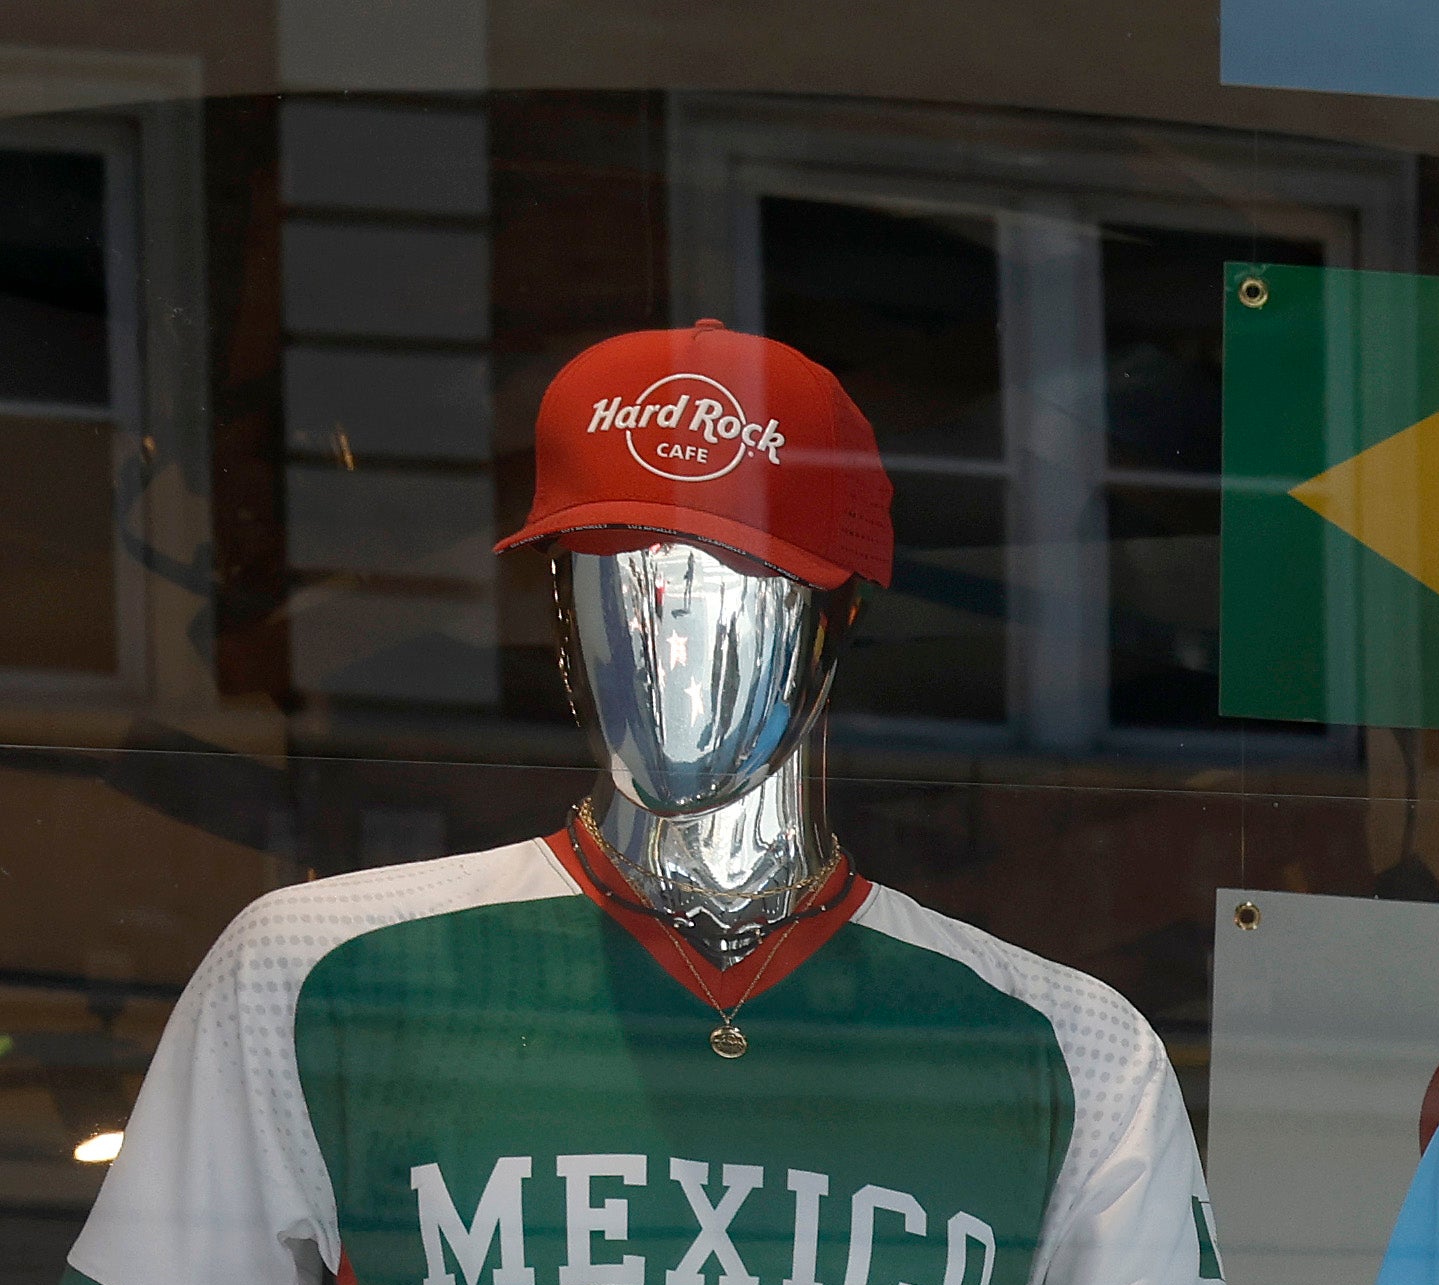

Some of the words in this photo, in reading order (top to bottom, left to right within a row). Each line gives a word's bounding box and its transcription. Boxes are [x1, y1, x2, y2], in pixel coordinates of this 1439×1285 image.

[587, 393, 692, 435] Hard
[688, 397, 786, 466] Rock
[655, 441, 709, 466] CAFE
